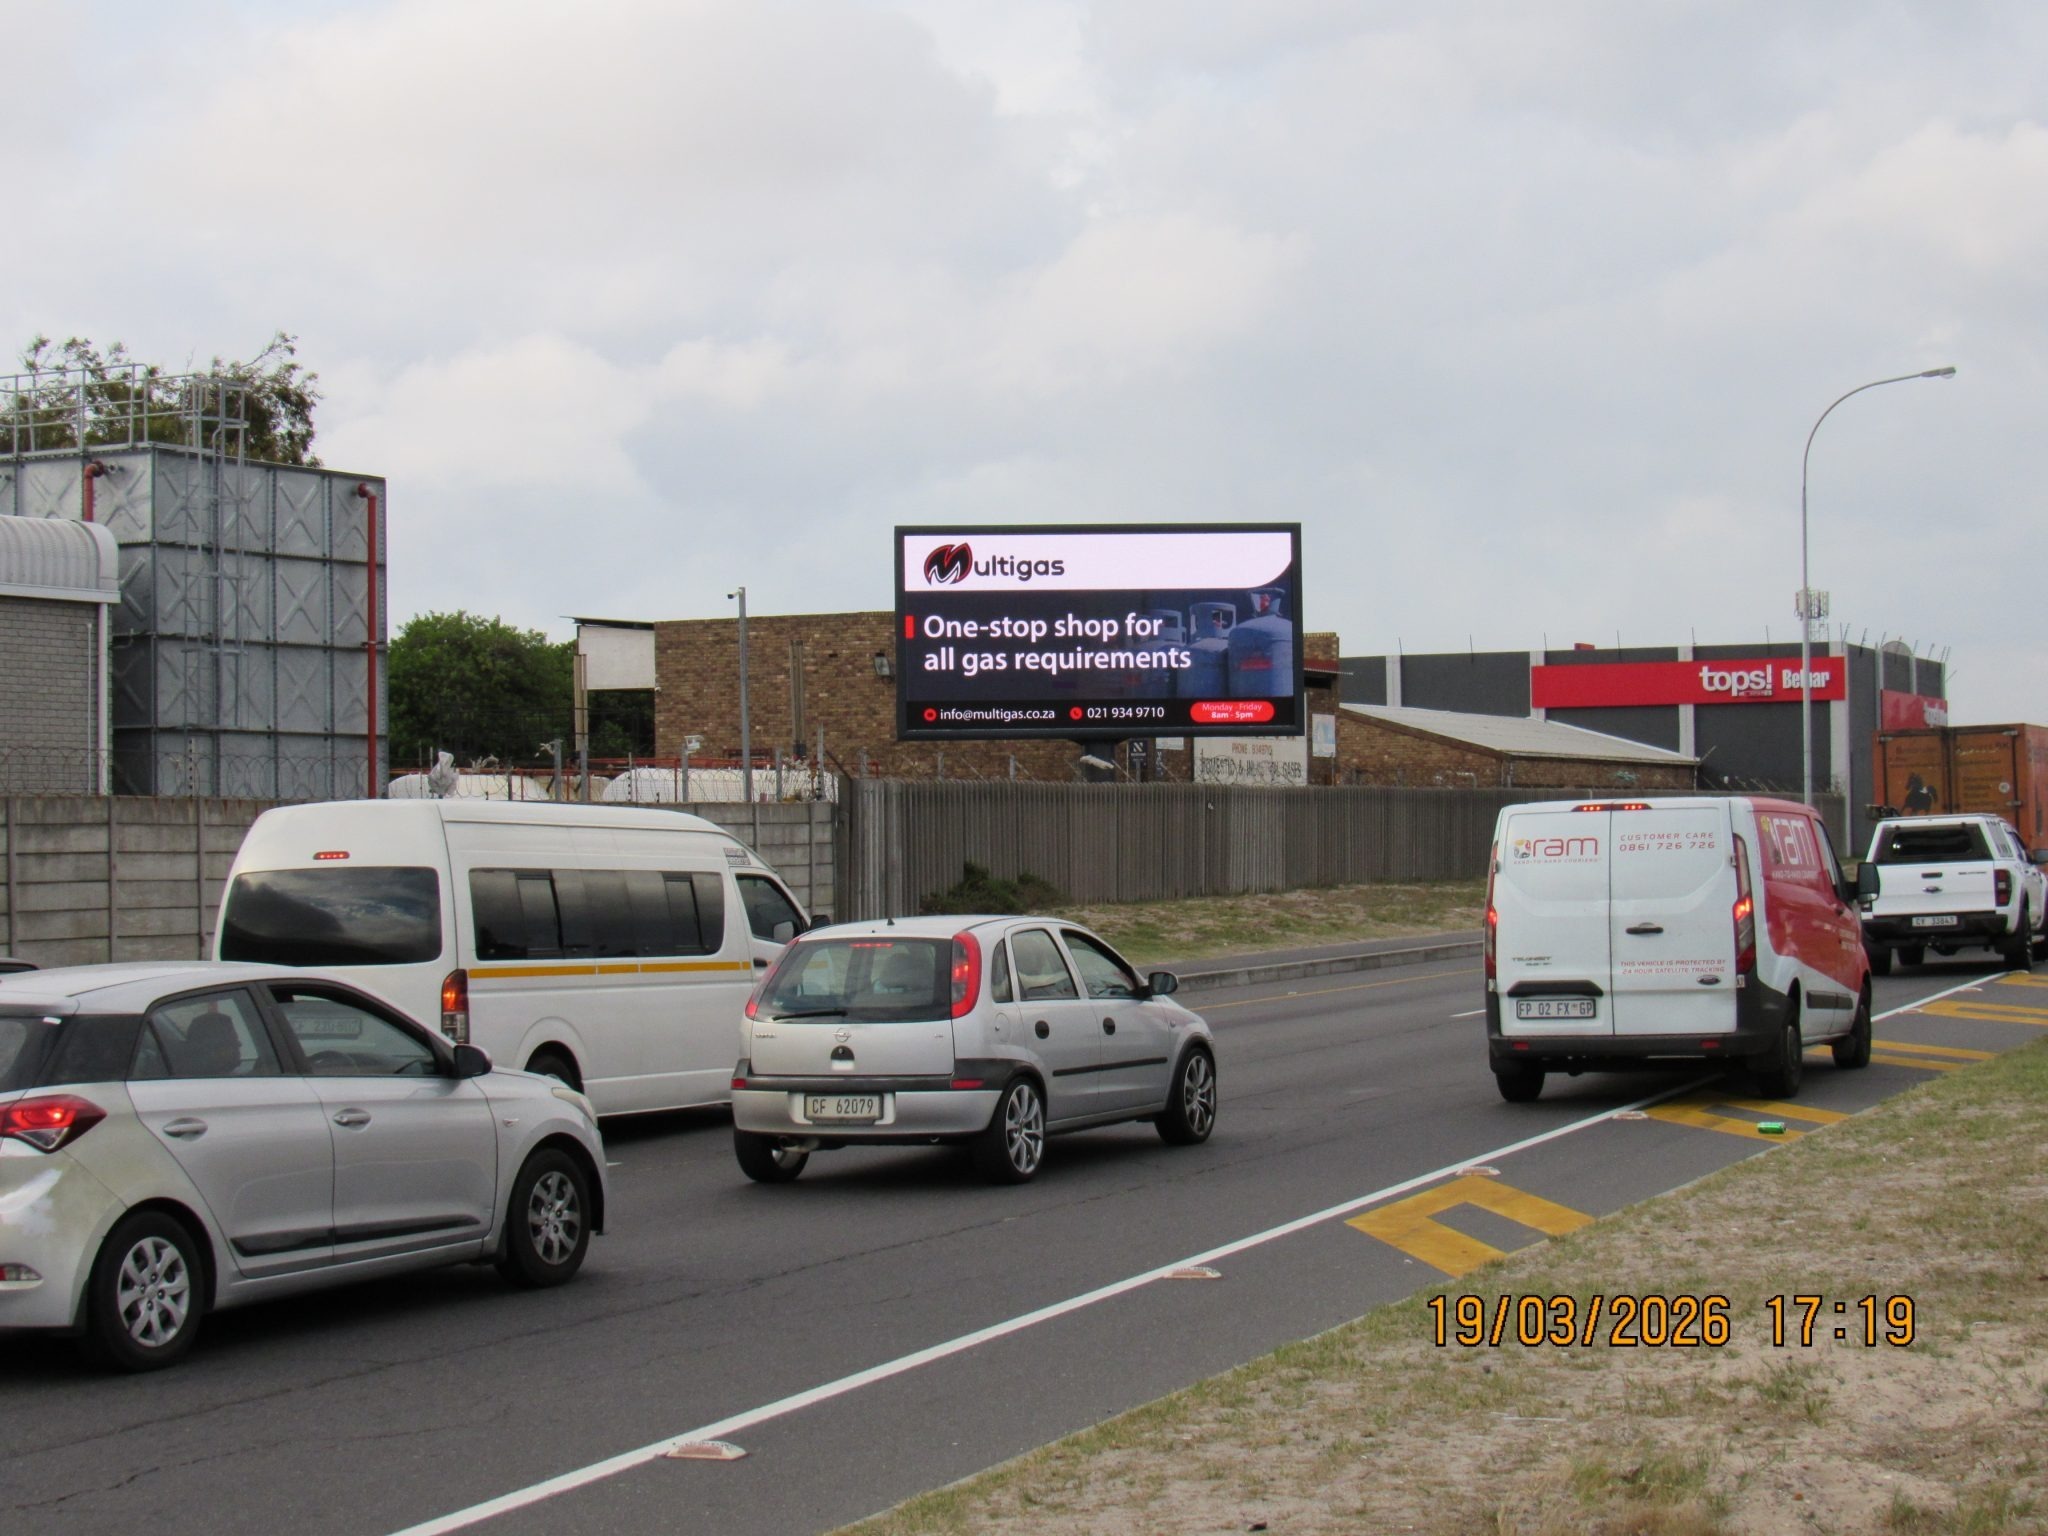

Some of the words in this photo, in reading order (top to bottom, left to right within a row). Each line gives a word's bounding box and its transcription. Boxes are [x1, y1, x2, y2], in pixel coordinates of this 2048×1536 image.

[924, 615, 1047, 643] One-stop
[1054, 613, 1119, 642] shop
[1125, 612, 1163, 636] for
[924, 647, 954, 670] all
[962, 652, 1007, 676] gas
[1015, 646, 1192, 675] requirements
[1699, 664, 1772, 697] tops!
[1087, 707, 1108, 719] 021
[1111, 707, 1133, 718] 934
[1135, 706, 1165, 718] 9710
[1202, 703, 1233, 713] Monday
[1239, 702, 1262, 712] Friday
[940, 708, 1055, 722] info@multigas.co.za
[1211, 711, 1229, 719] 8am
[1235, 711, 1254, 720] 5pm
[1231, 742, 1248, 754] PHONE
[1620, 833, 1680, 841] CUSTOMER
[1533, 837, 1598, 857] ram
[1619, 843, 1650, 852] 0861
[1656, 842, 1682, 850] 726
[1689, 841, 1715, 849] 726
[1675, 959, 1716, 967] PROTECTED
[1519, 1003, 1532, 1016] FP
[1538, 1002, 1551, 1015] 02
[1557, 1002, 1570, 1015] FX
[1579, 1002, 1592, 1015] GP
[812, 1099, 827, 1114] CF
[836, 1099, 874, 1114] 62079
